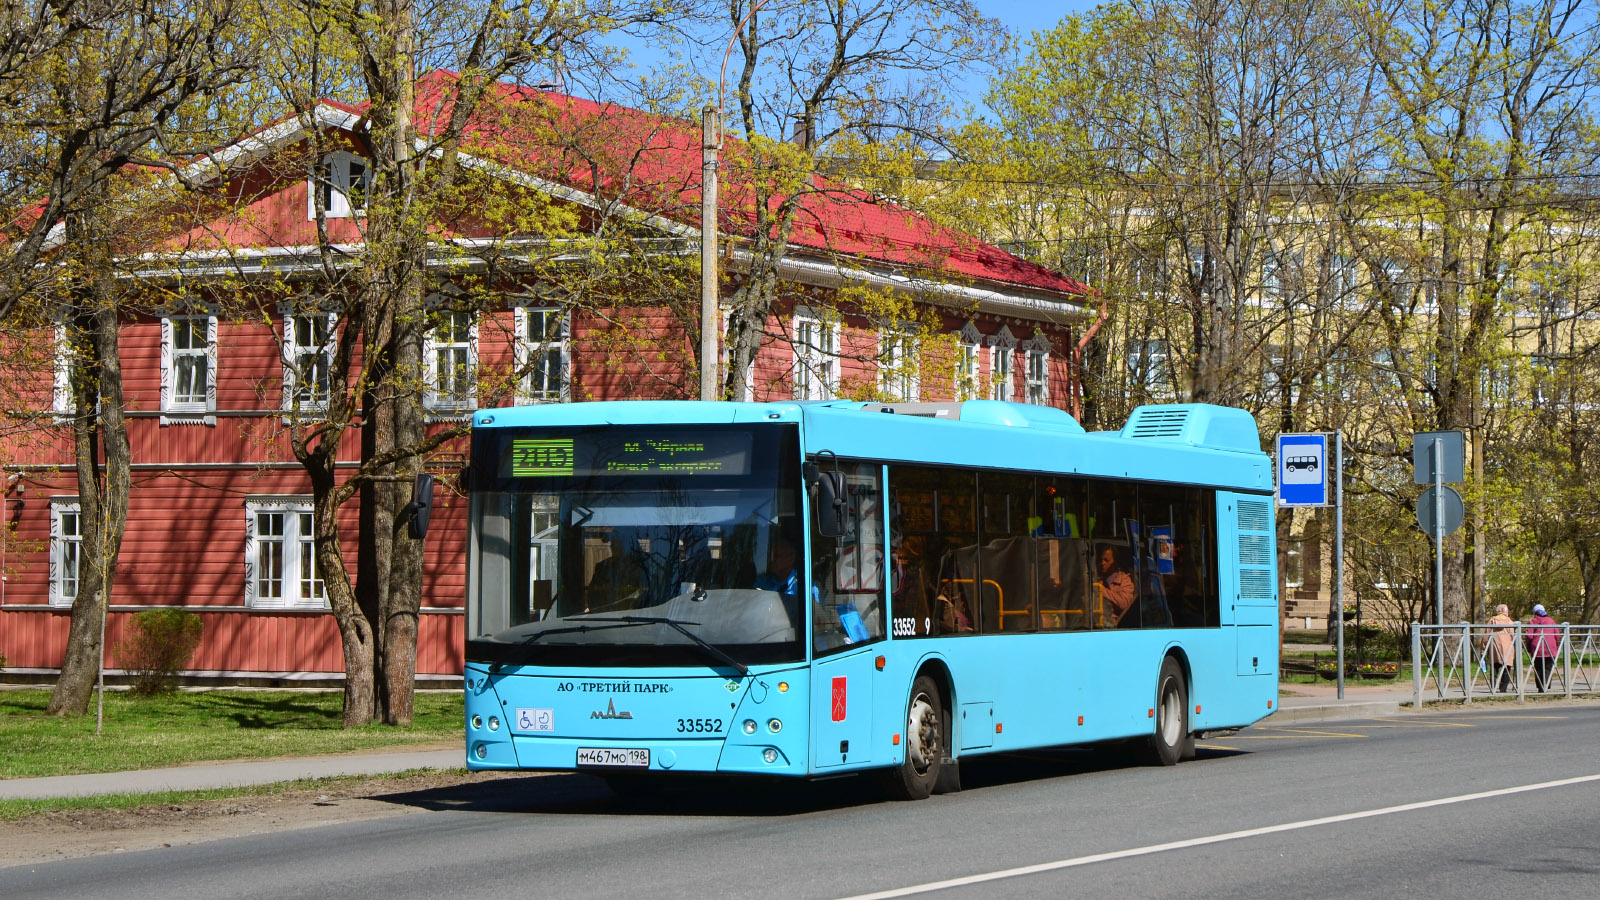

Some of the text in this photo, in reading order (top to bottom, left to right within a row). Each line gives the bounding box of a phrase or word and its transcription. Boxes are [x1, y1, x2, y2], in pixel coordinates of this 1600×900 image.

[893, 617, 916, 636] 33552
[924, 617, 931, 636] 9
[557, 680, 674, 694] АО «ТРЕТИЙ ПАРК»
[676, 718, 723, 733] 33552
[628, 750, 646, 760] 198
